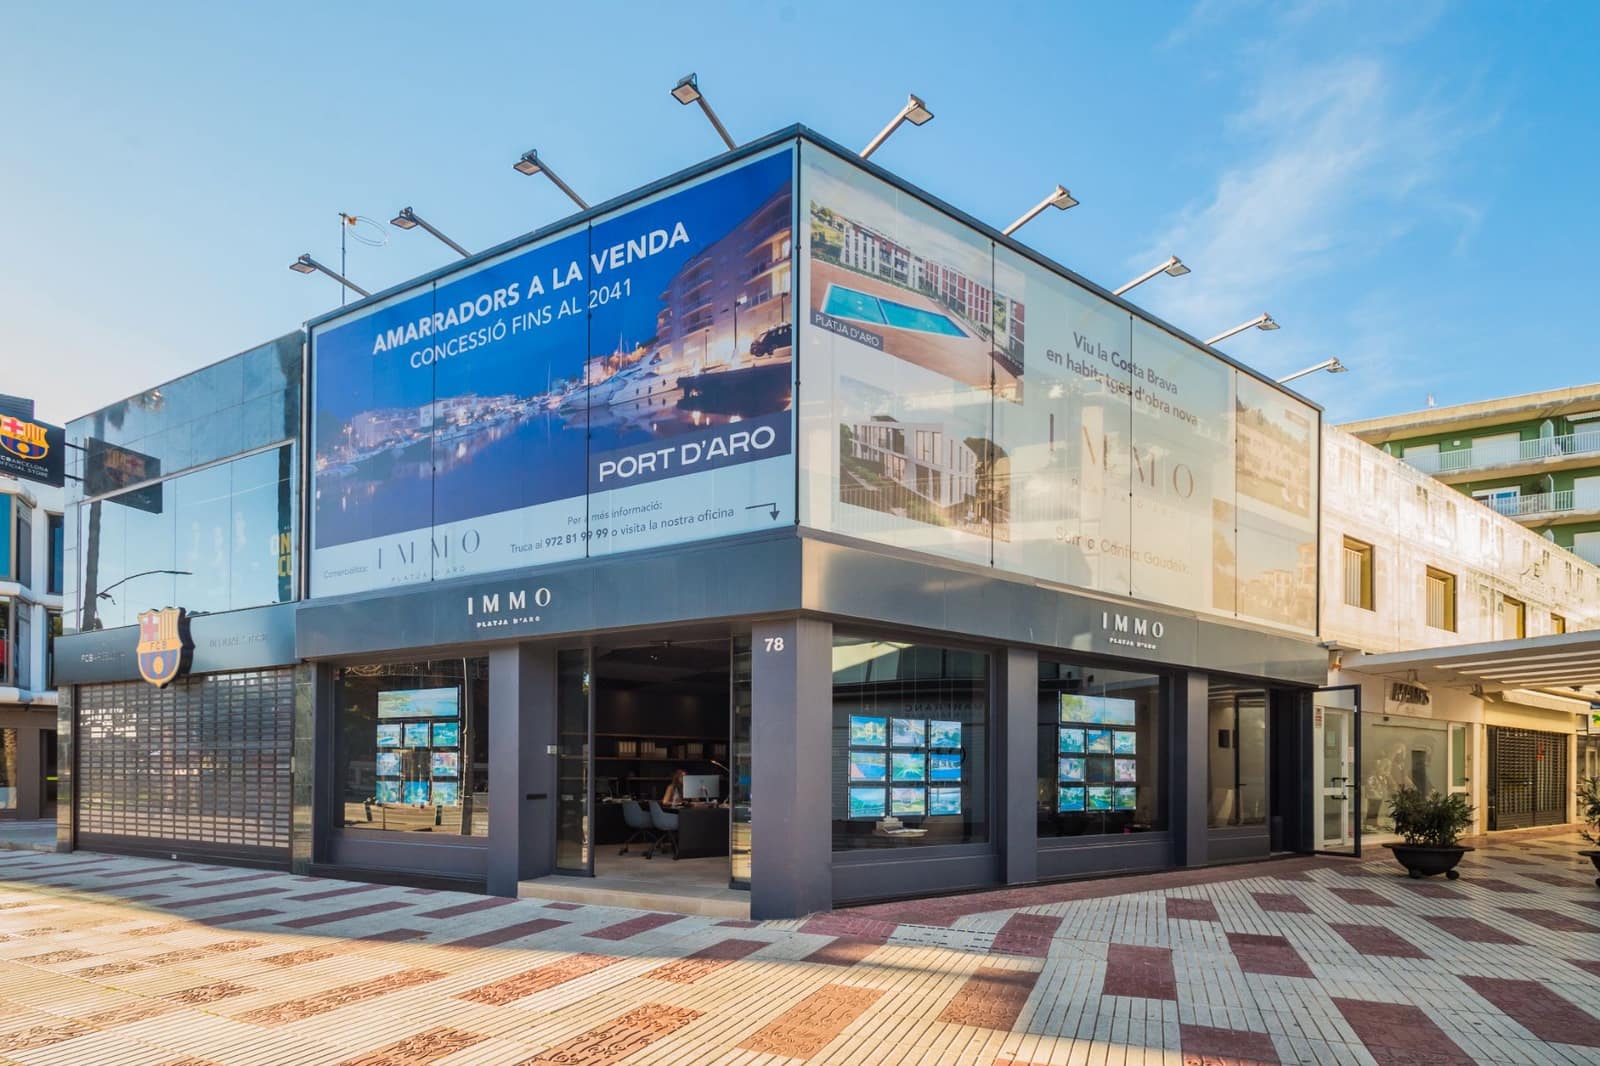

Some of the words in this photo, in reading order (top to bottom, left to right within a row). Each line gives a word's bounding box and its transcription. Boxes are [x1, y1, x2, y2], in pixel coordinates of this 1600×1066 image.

[372, 283, 520, 356] AMARRADORS
[527, 275, 545, 300] A
[552, 260, 584, 290] LA
[590, 221, 691, 275] VENDA
[410, 318, 507, 369] CONCESSIÓ
[512, 305, 552, 335] FINS
[557, 296, 582, 320] AL
[587, 277, 631, 309] 2041
[815, 314, 849, 336] PLATJA
[850, 327, 880, 347] D'ARO
[1073, 331, 1094, 356] Viu
[1097, 342, 1108, 362] la
[1111, 351, 1144, 379] Costa
[1147, 368, 1178, 395] Brava
[1046, 348, 1063, 364] en
[1134, 386, 1170, 414] d'obra
[1172, 406, 1198, 426] nova
[0, 455, 48, 472] CBARCELONA
[599, 447, 676, 483] PORT
[681, 425, 776, 466] D'ARO
[567, 516, 581, 526] Per
[611, 500, 662, 519] informació:
[510, 543, 533, 553] Truca
[535, 539, 543, 550] al
[545, 535, 563, 547] 972
[565, 533, 577, 544] 81
[580, 530, 593, 542] 99
[595, 527, 609, 539] 99
[611, 529, 618, 537] o
[620, 522, 646, 536] visita
[649, 519, 658, 530] la
[661, 514, 694, 528] nostra
[697, 508, 735, 522] oficina
[377, 528, 480, 570] IMMO
[467, 587, 551, 616] IMMO
[476, 619, 508, 628] PLATJA
[1102, 611, 1164, 638] IMMO
[150, 640, 167, 650] FCB
[764, 637, 785, 652] 78
